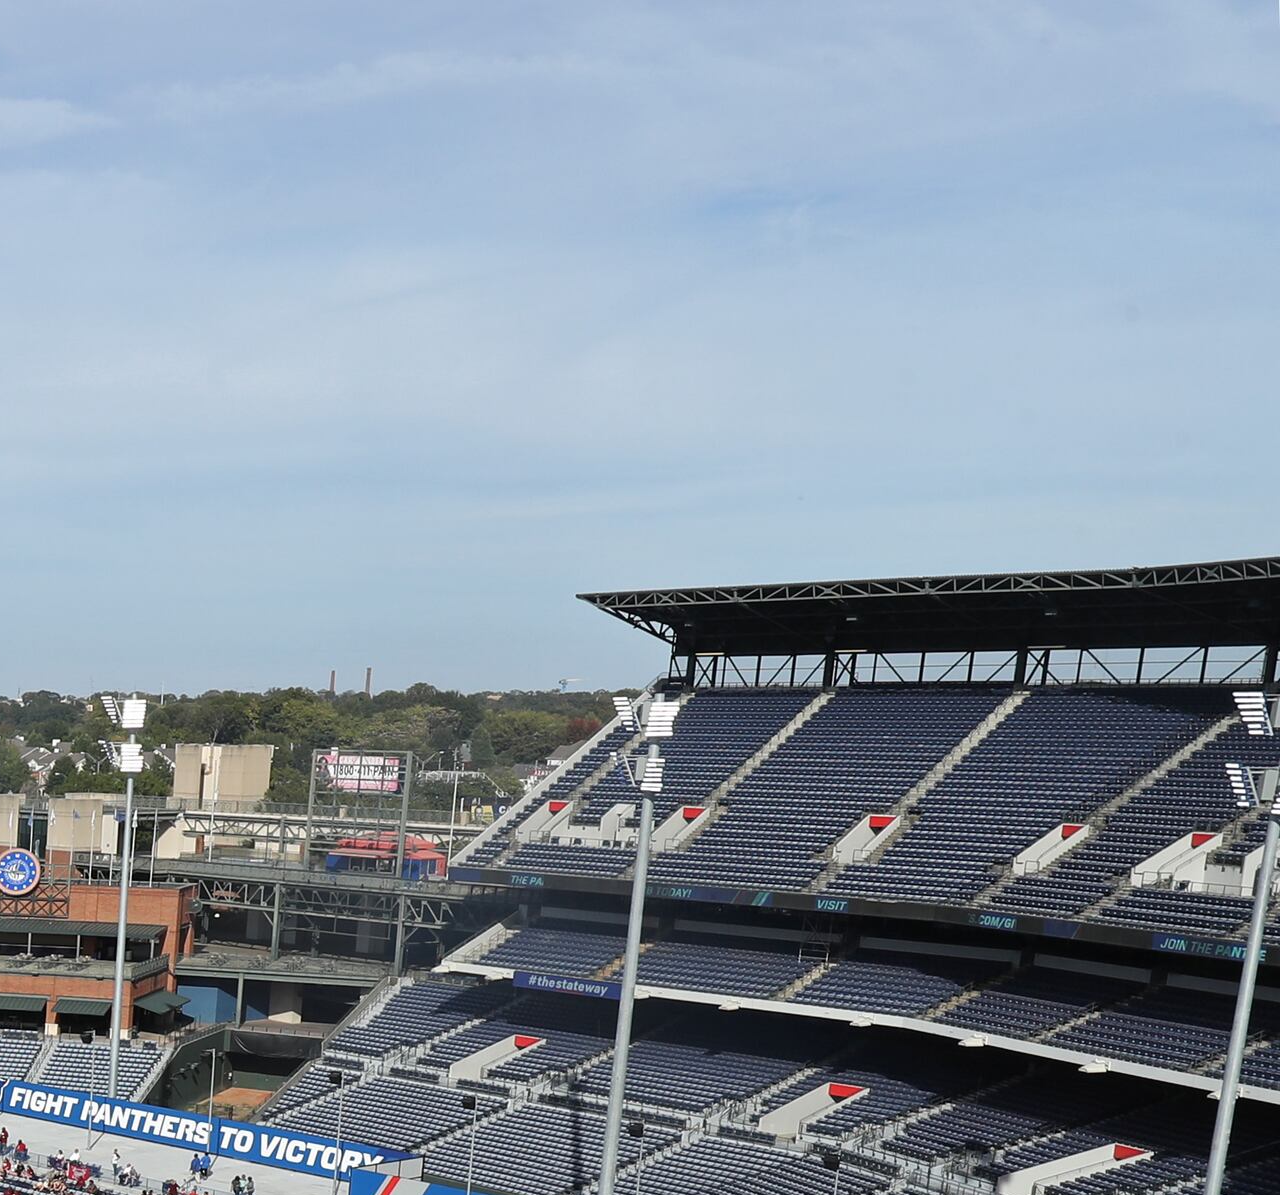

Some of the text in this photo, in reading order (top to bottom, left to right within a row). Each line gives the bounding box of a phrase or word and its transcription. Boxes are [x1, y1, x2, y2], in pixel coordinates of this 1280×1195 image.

[511, 875, 526, 886] THE
[656, 888, 692, 898] TODAY!
[816, 900, 847, 911] VISIT
[1160, 938, 1212, 954] JOIN THE
[528, 974, 609, 996] #thestateway
[9, 1086, 384, 1174] FIGHT PANTHERS TO VICTORY
